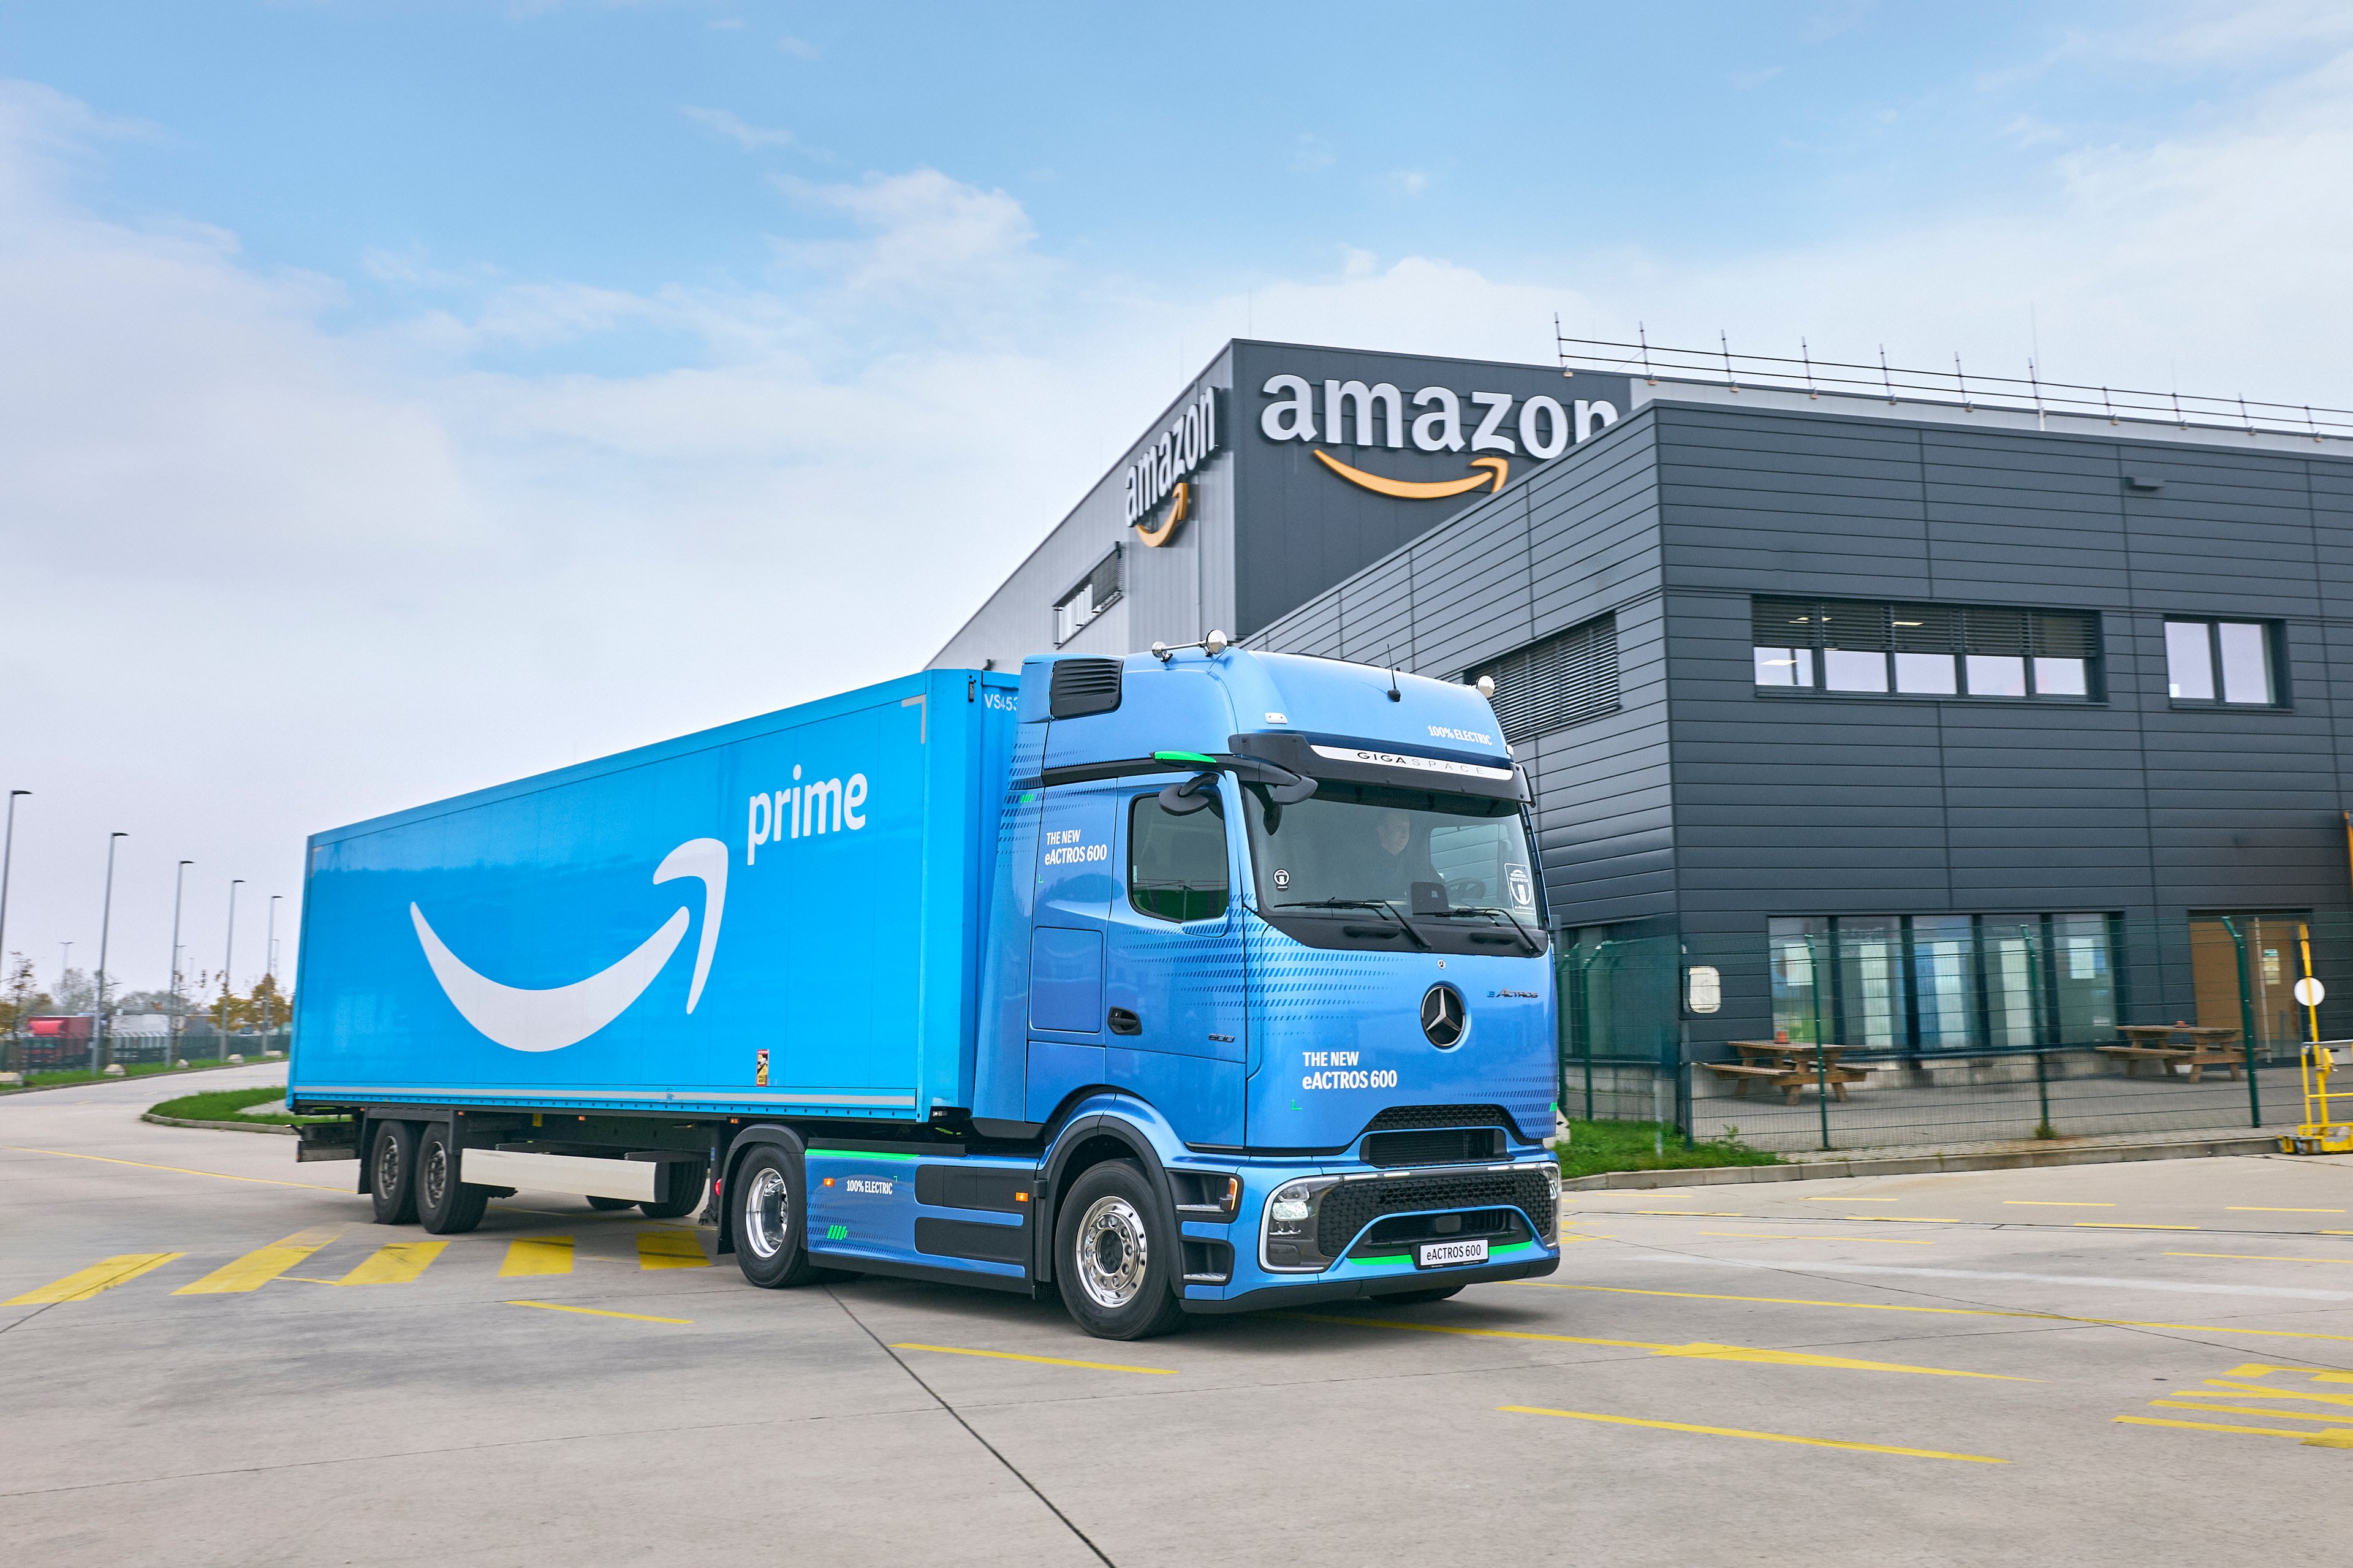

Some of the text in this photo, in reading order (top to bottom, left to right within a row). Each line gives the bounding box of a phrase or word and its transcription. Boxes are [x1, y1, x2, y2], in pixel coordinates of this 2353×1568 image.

[1261, 373, 1618, 459] amazon
[1125, 387, 1215, 528] amazon
[1427, 725, 1493, 746] 100% ELECTRIC
[747, 764, 868, 866] prime
[1046, 829, 1082, 846] THE NEW
[1045, 844, 1107, 865] eACTROS 600
[1302, 1051, 1359, 1067] THE NEW
[1302, 1069, 1398, 1090] eACTROS 600
[846, 1180, 893, 1195] 100% ELECTRIC
[1427, 1244, 1481, 1260] eACTROS 600
